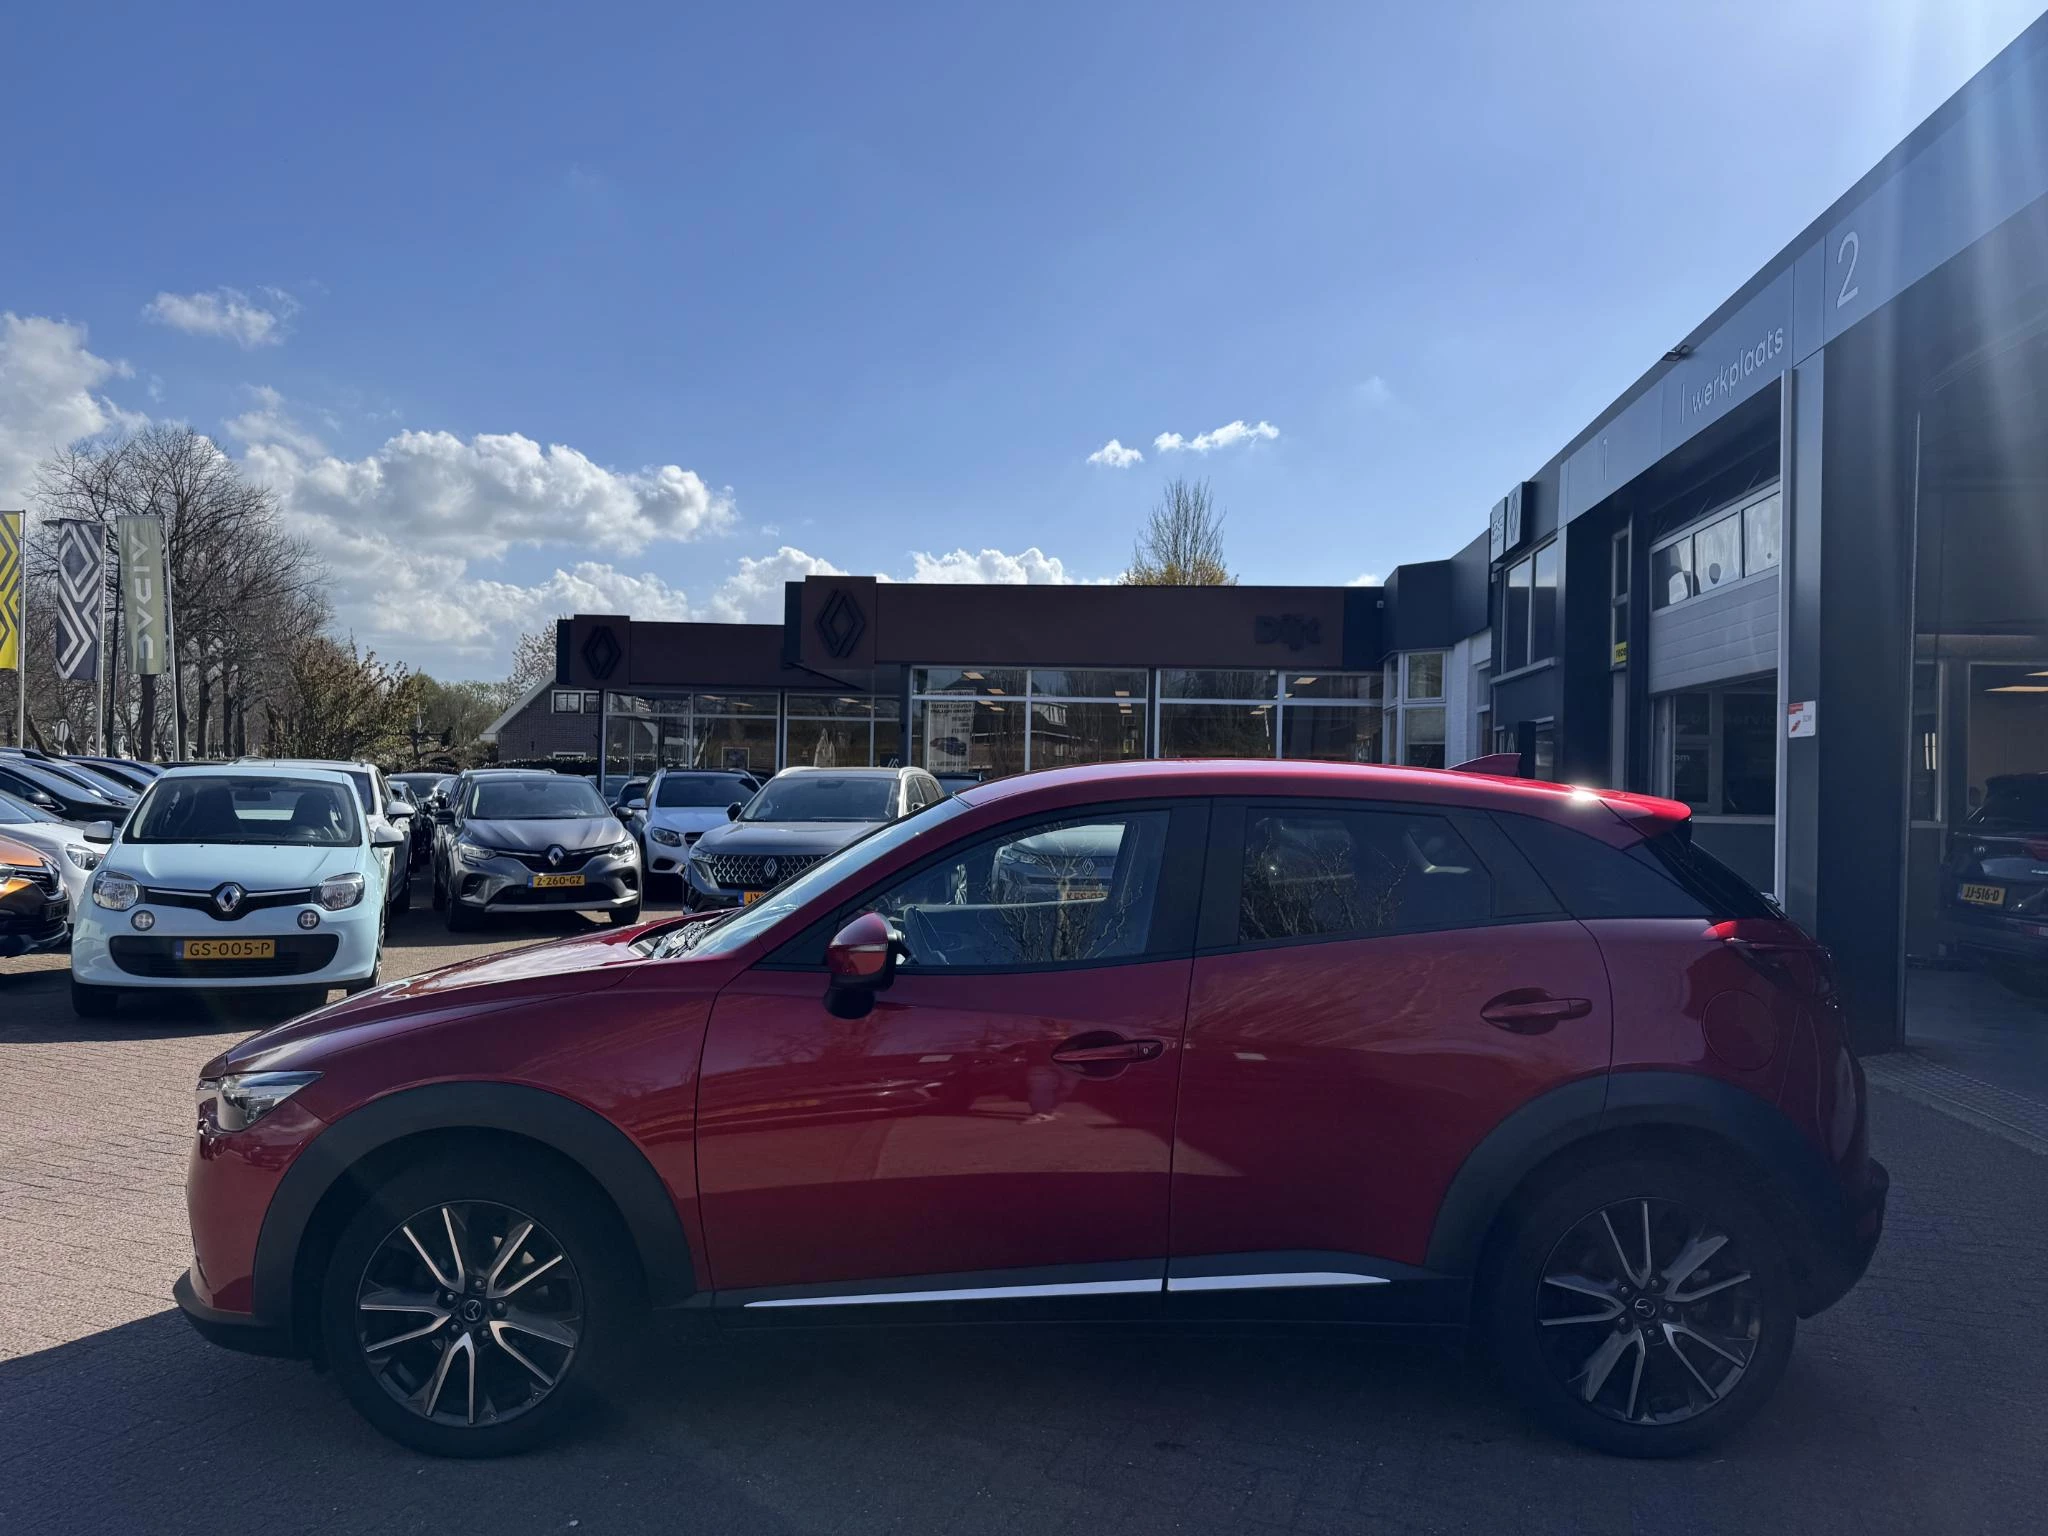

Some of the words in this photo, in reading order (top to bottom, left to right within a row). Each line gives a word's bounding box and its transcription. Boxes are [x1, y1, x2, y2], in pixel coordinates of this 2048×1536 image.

[1837, 231, 1859, 310] 2
[1692, 327, 1783, 416] werkplaats
[536, 875, 582, 886] Z-260-GZ
[1964, 886, 2000, 902] JJ-516-D
[189, 942, 271, 956] GS-005-P
